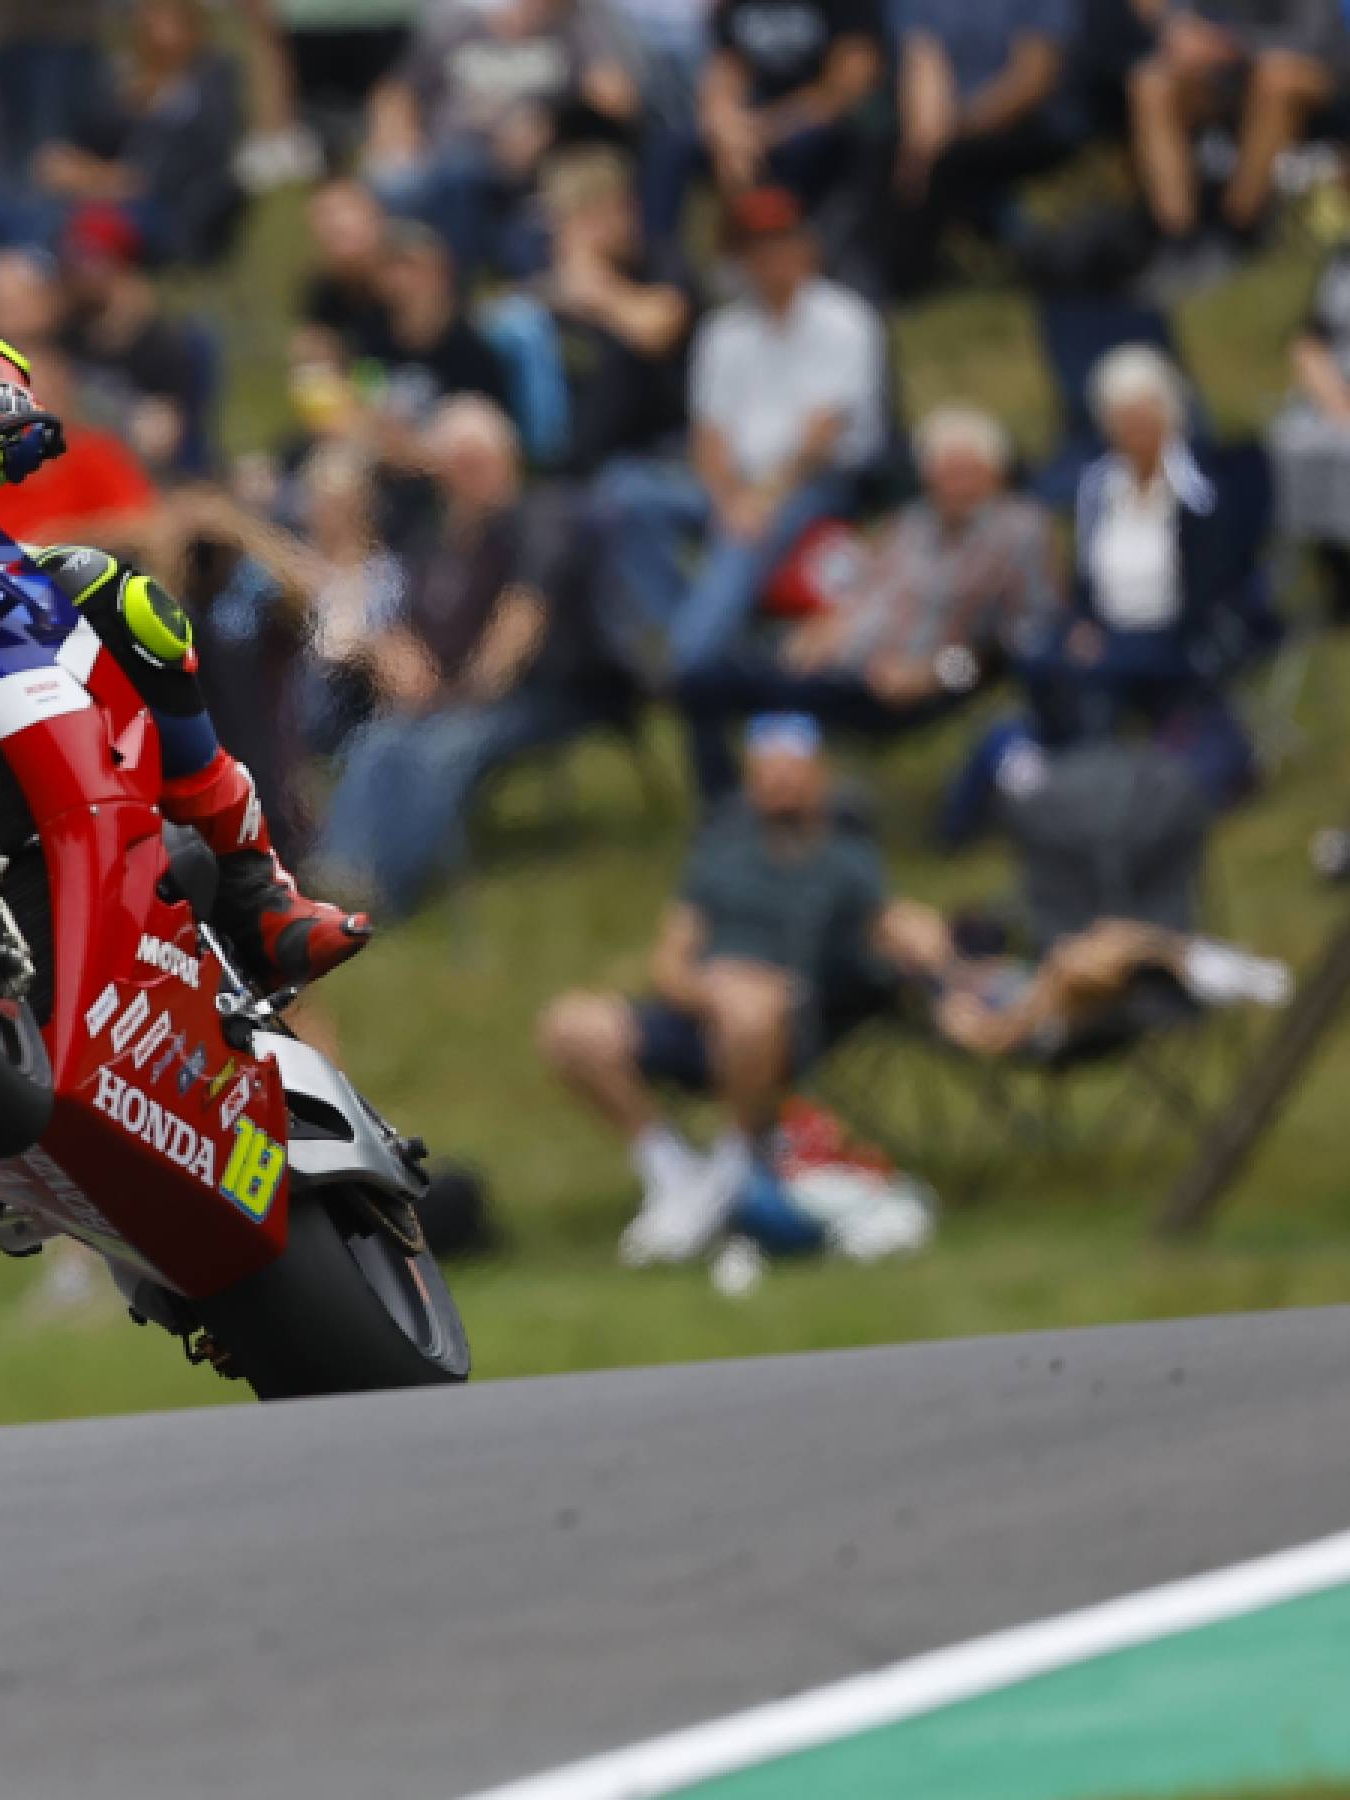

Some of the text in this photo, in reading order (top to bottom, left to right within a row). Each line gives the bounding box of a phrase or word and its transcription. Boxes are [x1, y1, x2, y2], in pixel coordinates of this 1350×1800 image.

[136, 932, 199, 989] MOTUL
[92, 1064, 215, 1188] HONDA
[217, 1115, 288, 1225] 18
